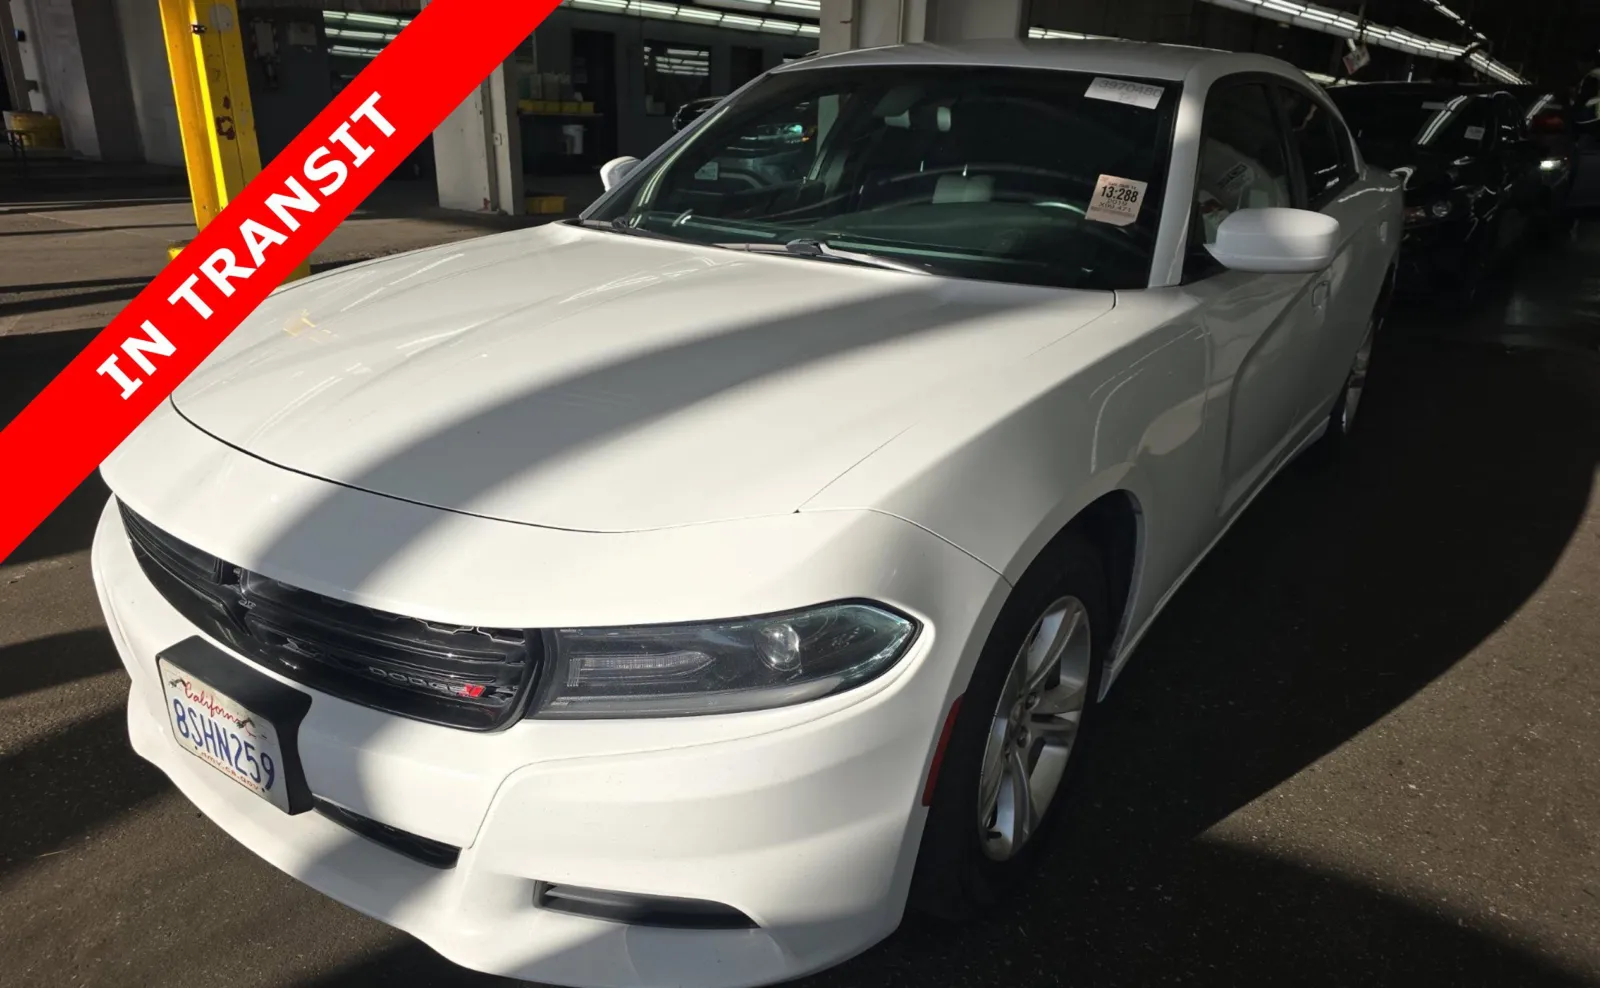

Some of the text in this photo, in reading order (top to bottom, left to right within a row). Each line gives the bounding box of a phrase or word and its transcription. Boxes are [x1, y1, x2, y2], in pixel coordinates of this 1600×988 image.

[1101, 186, 1139, 203] 13:288
[368, 667, 468, 693] DODGE
[183, 680, 257, 738] Californi
[173, 698, 275, 791] 8SHN259
